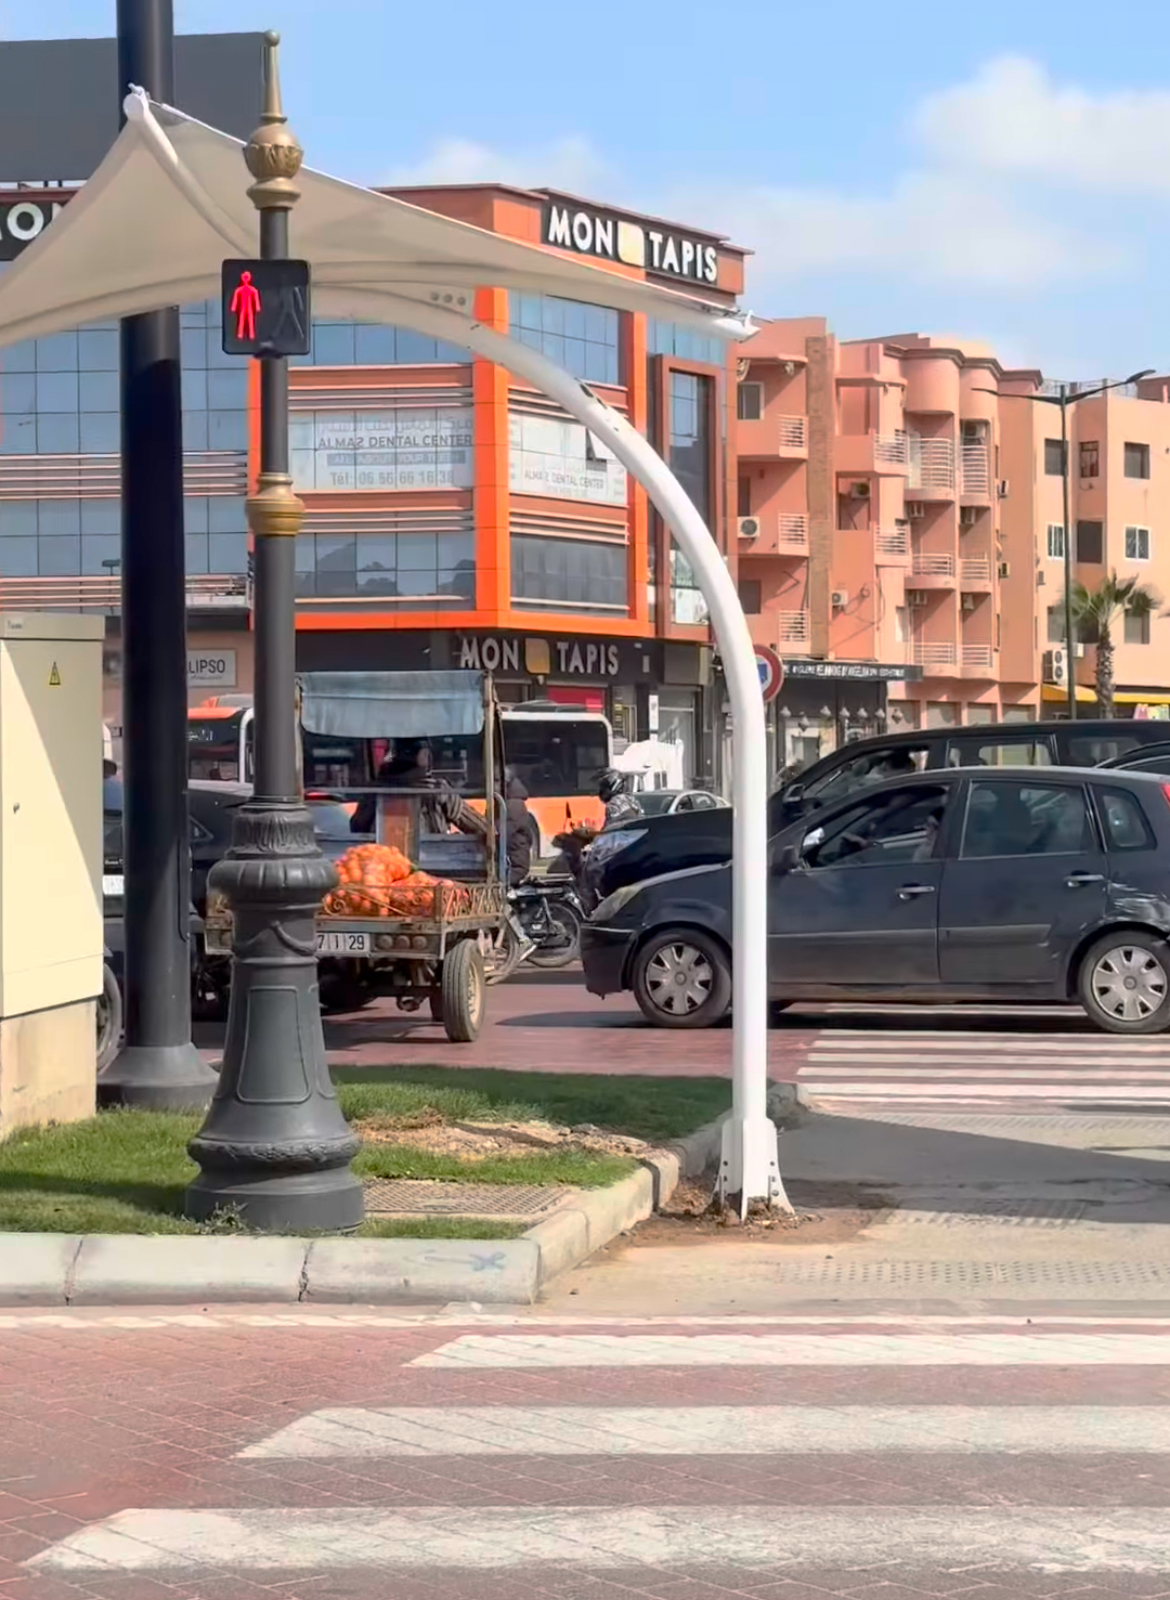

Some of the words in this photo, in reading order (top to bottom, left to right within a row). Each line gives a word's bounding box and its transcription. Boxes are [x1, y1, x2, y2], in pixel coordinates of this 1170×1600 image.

[548, 205, 613, 256] MON
[649, 231, 718, 281] TAPIS
[368, 435, 419, 448] DENTAL
[422, 434, 473, 447] CENTER
[460, 638, 519, 670] MON
[556, 641, 619, 675] TAPIS
[187, 659, 225, 673] LIPSO
[349, 935, 365, 950] 29
